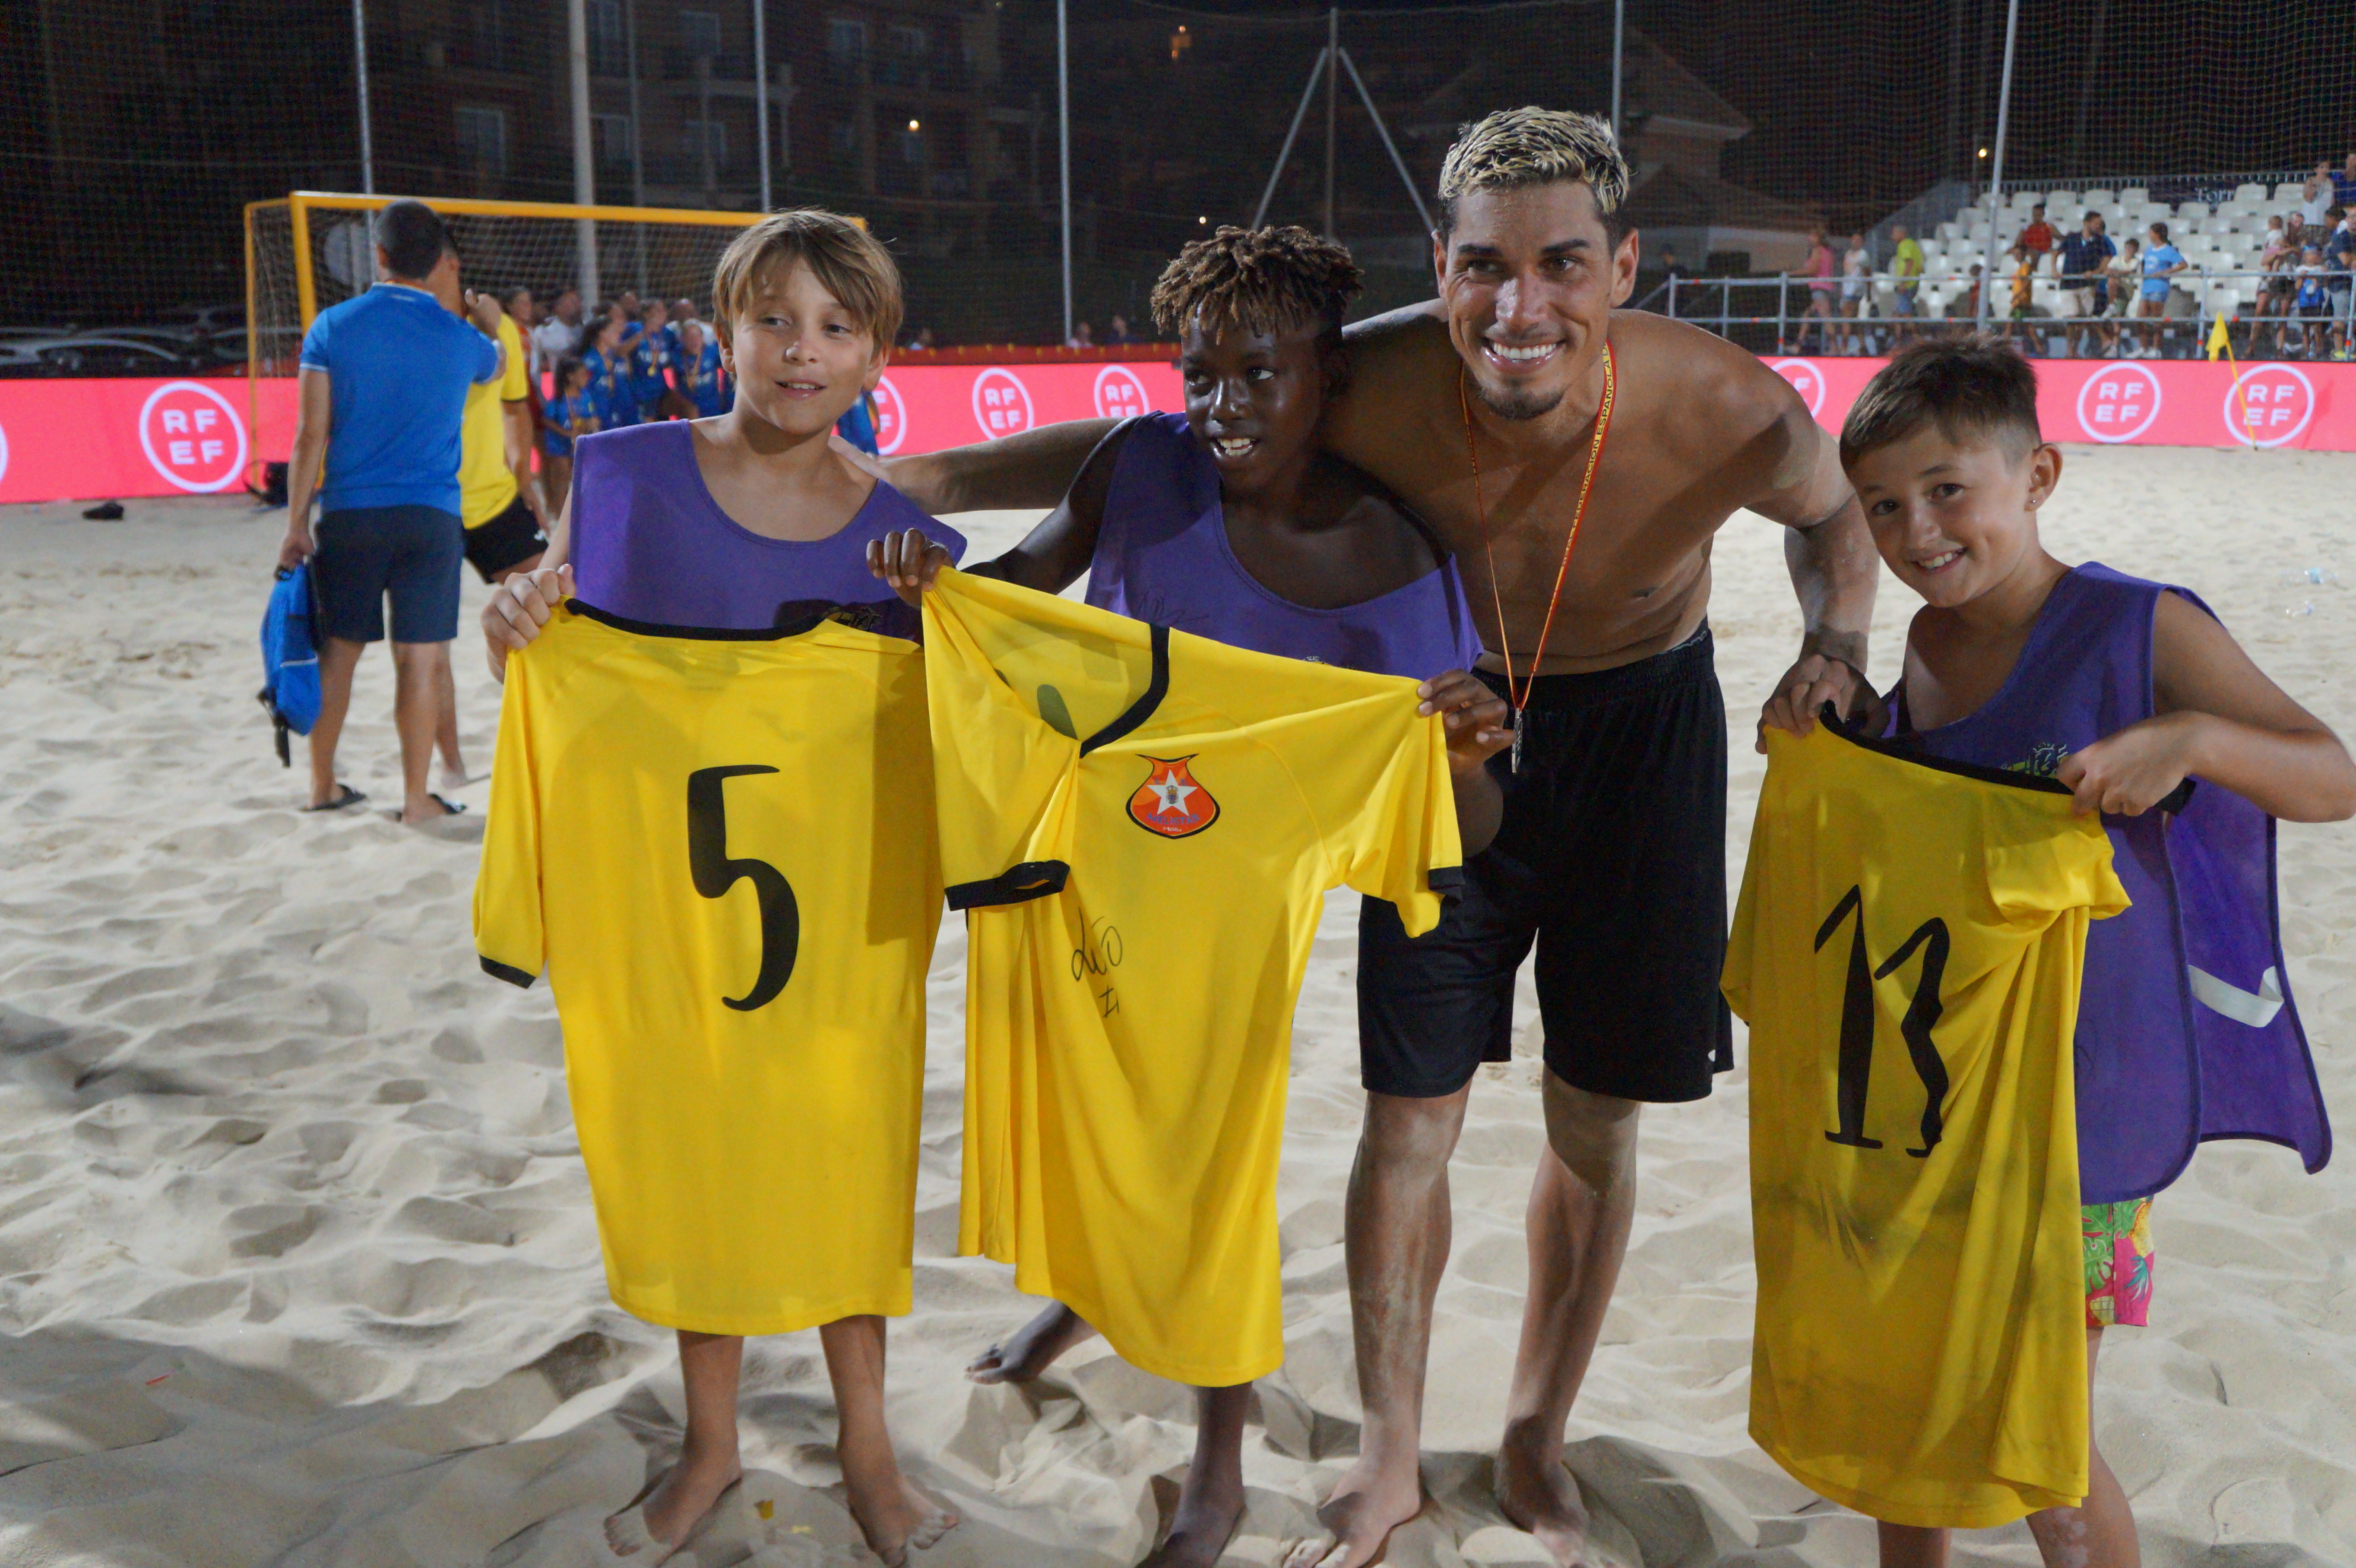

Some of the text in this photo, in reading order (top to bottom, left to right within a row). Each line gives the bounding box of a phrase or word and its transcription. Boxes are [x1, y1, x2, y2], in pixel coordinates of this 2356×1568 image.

[984, 388, 1016, 406] RF
[1105, 384, 1133, 401] RF
[2099, 383, 2144, 400] RF
[2247, 384, 2295, 402] RF
[163, 409, 217, 433] RF
[989, 411, 1021, 429] EF
[2095, 405, 2140, 422] EF
[2243, 408, 2291, 426] EF
[169, 440, 224, 465] EF
[1147, 812, 1200, 825] MELISTAR
[687, 764, 799, 1011] 5
